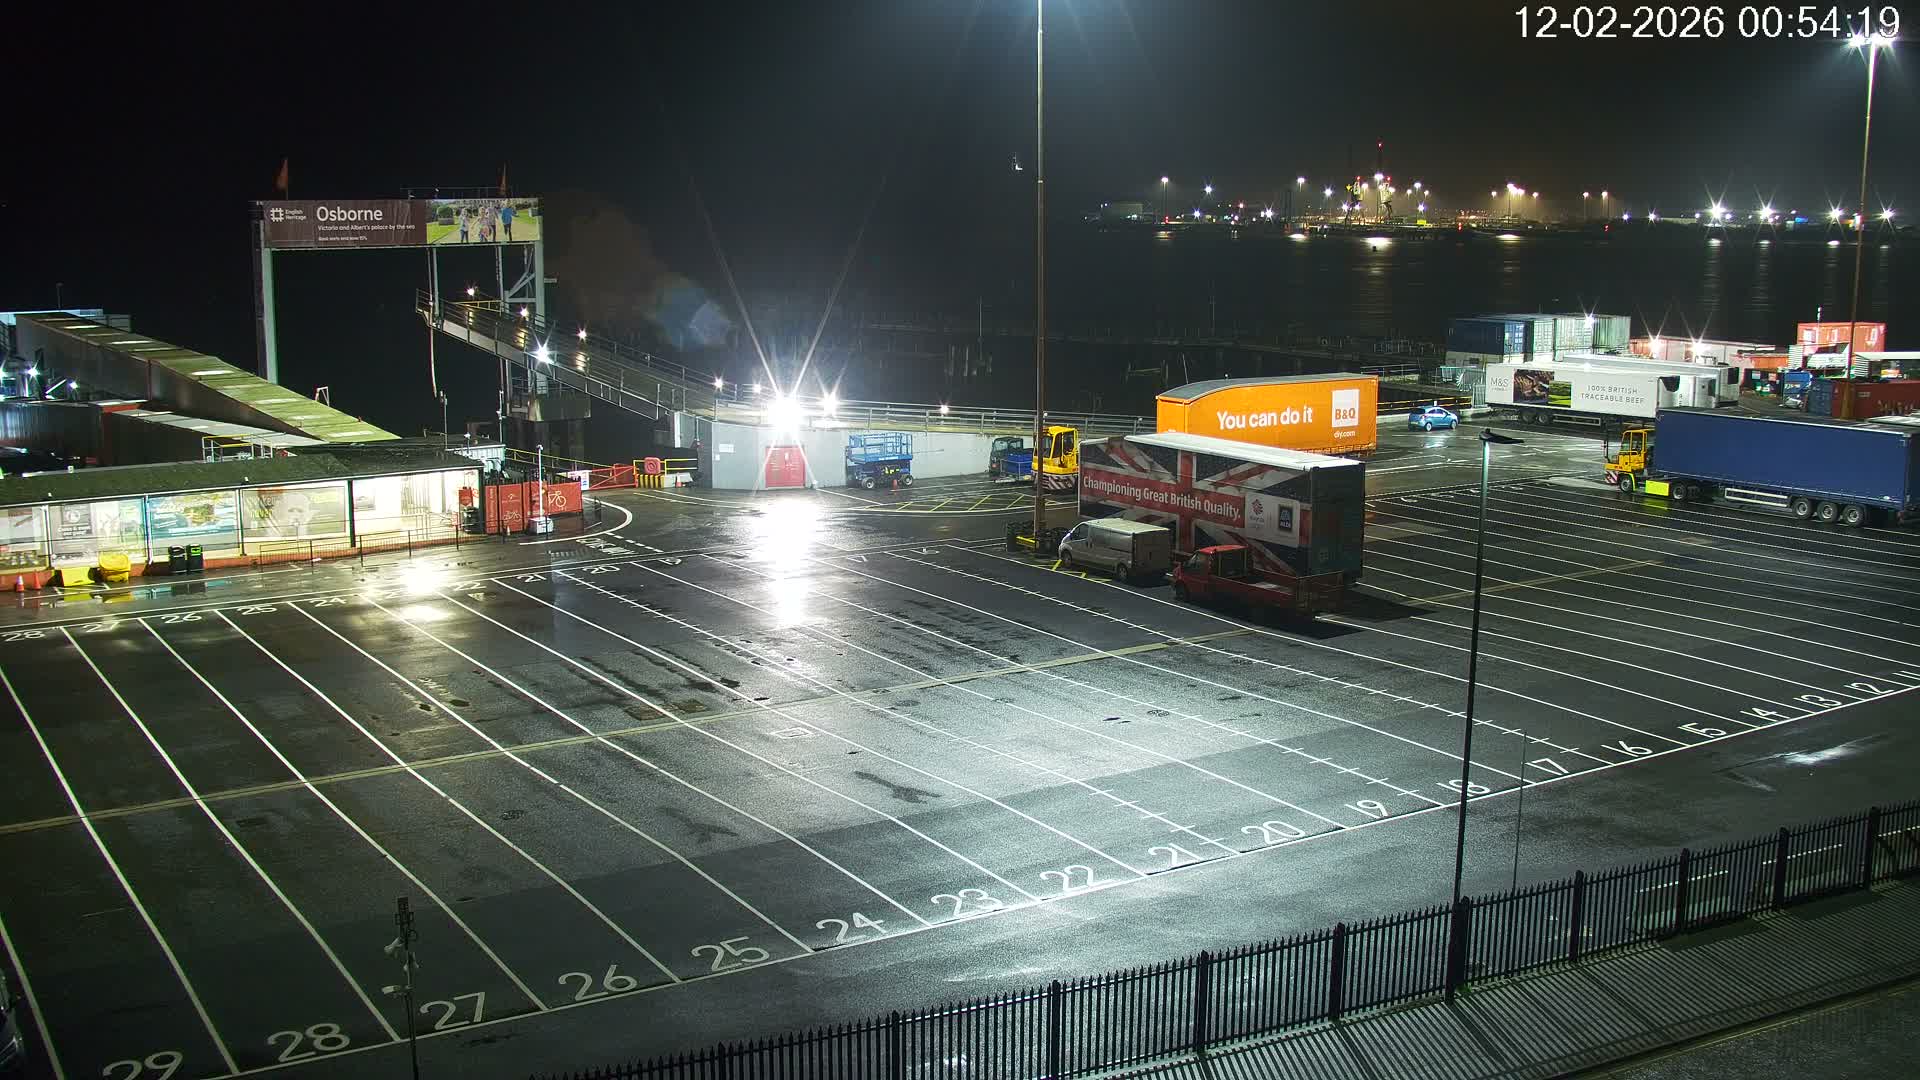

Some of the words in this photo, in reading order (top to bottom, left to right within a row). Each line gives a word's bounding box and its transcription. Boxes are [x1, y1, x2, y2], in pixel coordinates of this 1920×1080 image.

[317, 206, 383, 221] Osborne
[1490, 376, 1509, 388] M&S
[1587, 384, 1606, 392] 100%
[1608, 386, 1638, 394] BRITISH
[1581, 392, 1623, 402] TRACEABLE
[1625, 396, 1645, 404] BEEF
[1217, 410, 1246, 430] You
[1248, 411, 1277, 428] can
[1280, 406, 1300, 425] do
[1303, 404, 1313, 423] it
[1335, 407, 1356, 420] B&Q
[1333, 430, 1356, 439] diy.com
[1083, 476, 1142, 501] Championing
[1143, 487, 1169, 504] Great
[1170, 493, 1201, 511] British
[1203, 499, 1241, 522] Quality.
[516, 573, 547, 583] 21
[582, 565, 620, 575] 20
[236, 603, 278, 616] 25
[309, 597, 347, 608] 24
[161, 611, 203, 624] 26
[82, 621, 120, 633] 27
[0, 630, 46, 642] 28
[1843, 682, 1895, 695] 12
[1793, 694, 1842, 709] 13
[1740, 706, 1791, 722] 14
[1601, 740, 1654, 758] 16
[1525, 758, 1570, 776] 17
[1436, 779, 1490, 797] 18
[1344, 799, 1389, 820] 19
[1241, 820, 1306, 845] 20
[1148, 842, 1202, 868] 21
[1039, 864, 1113, 892] 22
[930, 888, 1001, 918] 23
[816, 911, 887, 945] 24
[691, 936, 770, 973] 25
[558, 964, 638, 1002] 26
[418, 991, 487, 1032] 27
[266, 1022, 351, 1063] 28
[102, 1050, 184, 1080] 29
